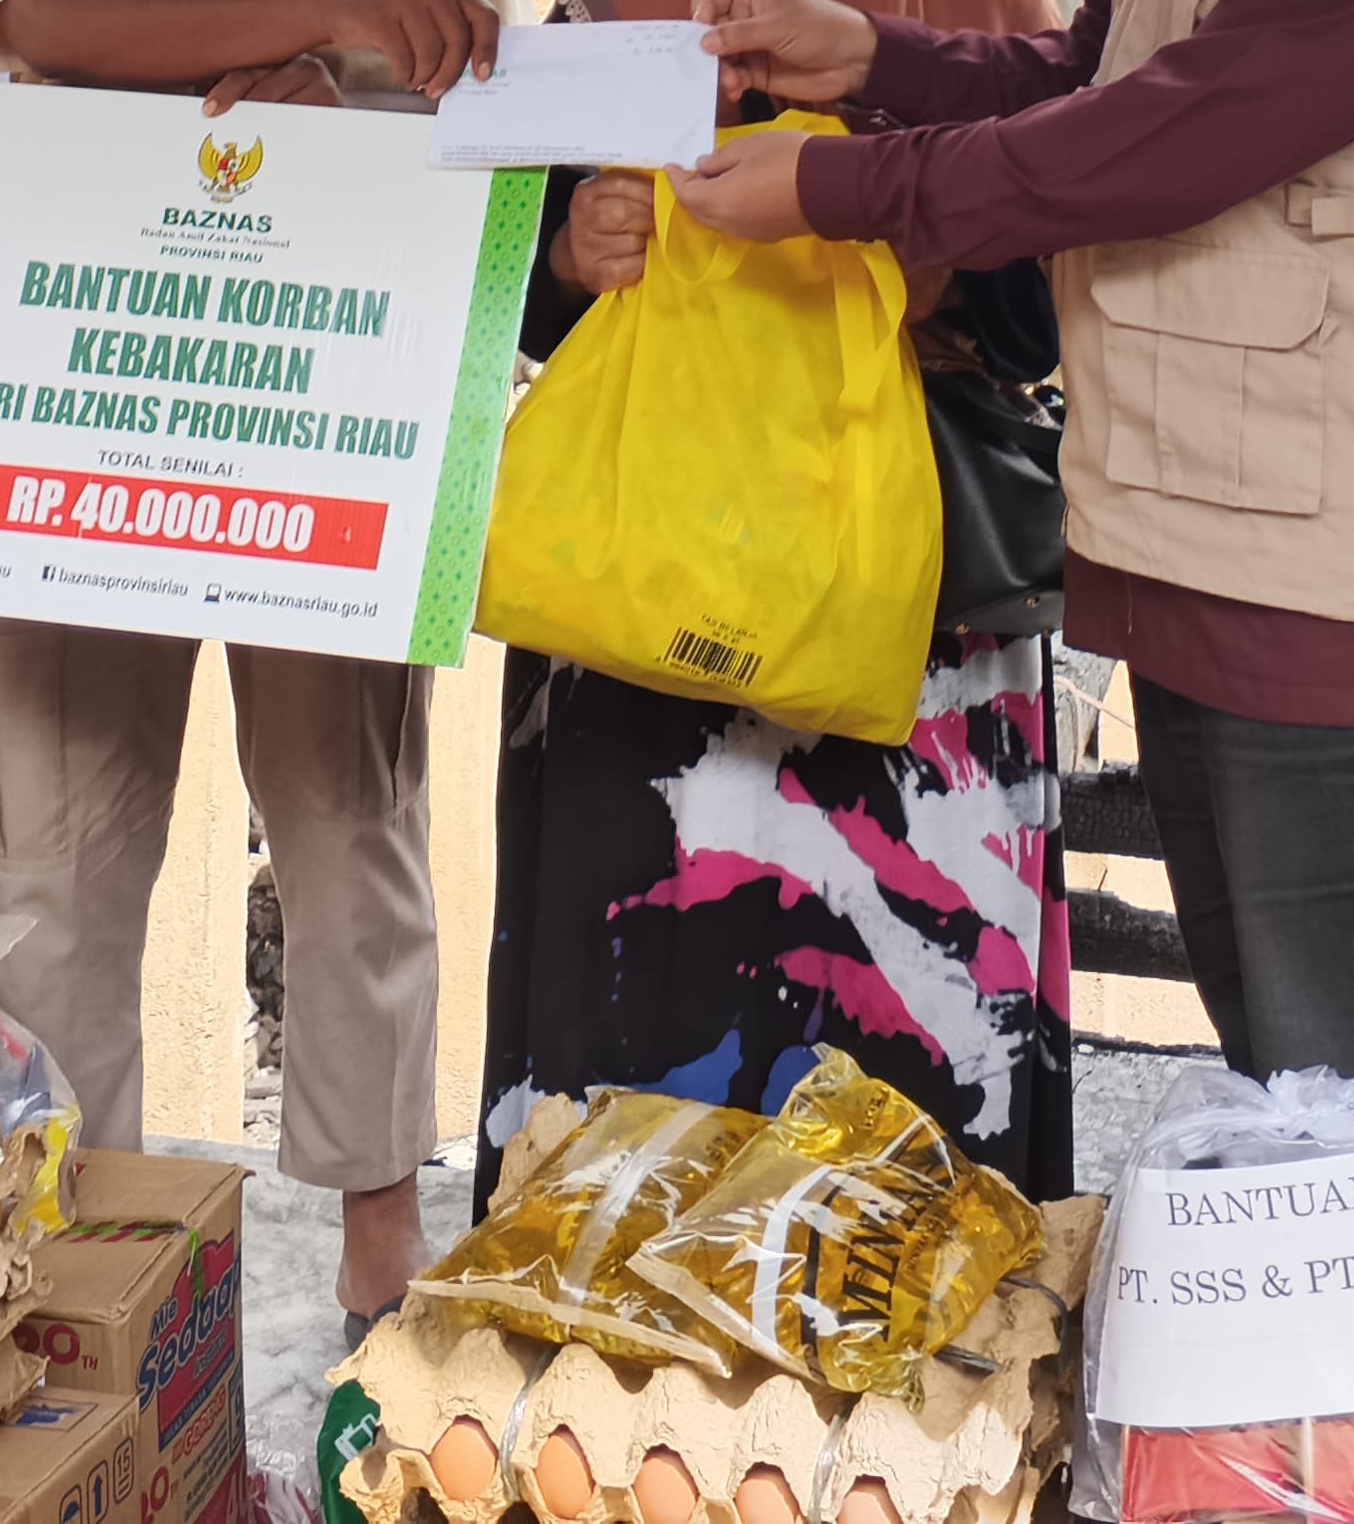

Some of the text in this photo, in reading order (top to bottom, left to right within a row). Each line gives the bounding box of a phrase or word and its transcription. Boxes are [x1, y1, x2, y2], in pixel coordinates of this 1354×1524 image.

[162, 207, 273, 233] BAZNAS
[160, 245, 263, 264] PROVINSI RIAU
[19, 260, 392, 338] BANTUAN KORBAN
[66, 326, 316, 395] KEBAKARAN
[31, 385, 162, 435] BAZNAS
[166, 399, 329, 452] PROVINSI
[333, 414, 420, 462] RIAU
[98, 449, 155, 471] TOTAL
[159, 454, 235, 478] SENILAI
[6, 475, 315, 553] RP. 40.000.000
[57, 566, 190, 598] baznasprovinsiriau
[223, 586, 379, 620] www.baznasriau.go.id
[1117, 1265, 1158, 1305] PT.
[1171, 1267, 1248, 1307] SSS
[1261, 1264, 1294, 1298] &
[150, 1293, 180, 1340] Mie
[116, 1449, 131, 1475] 15
